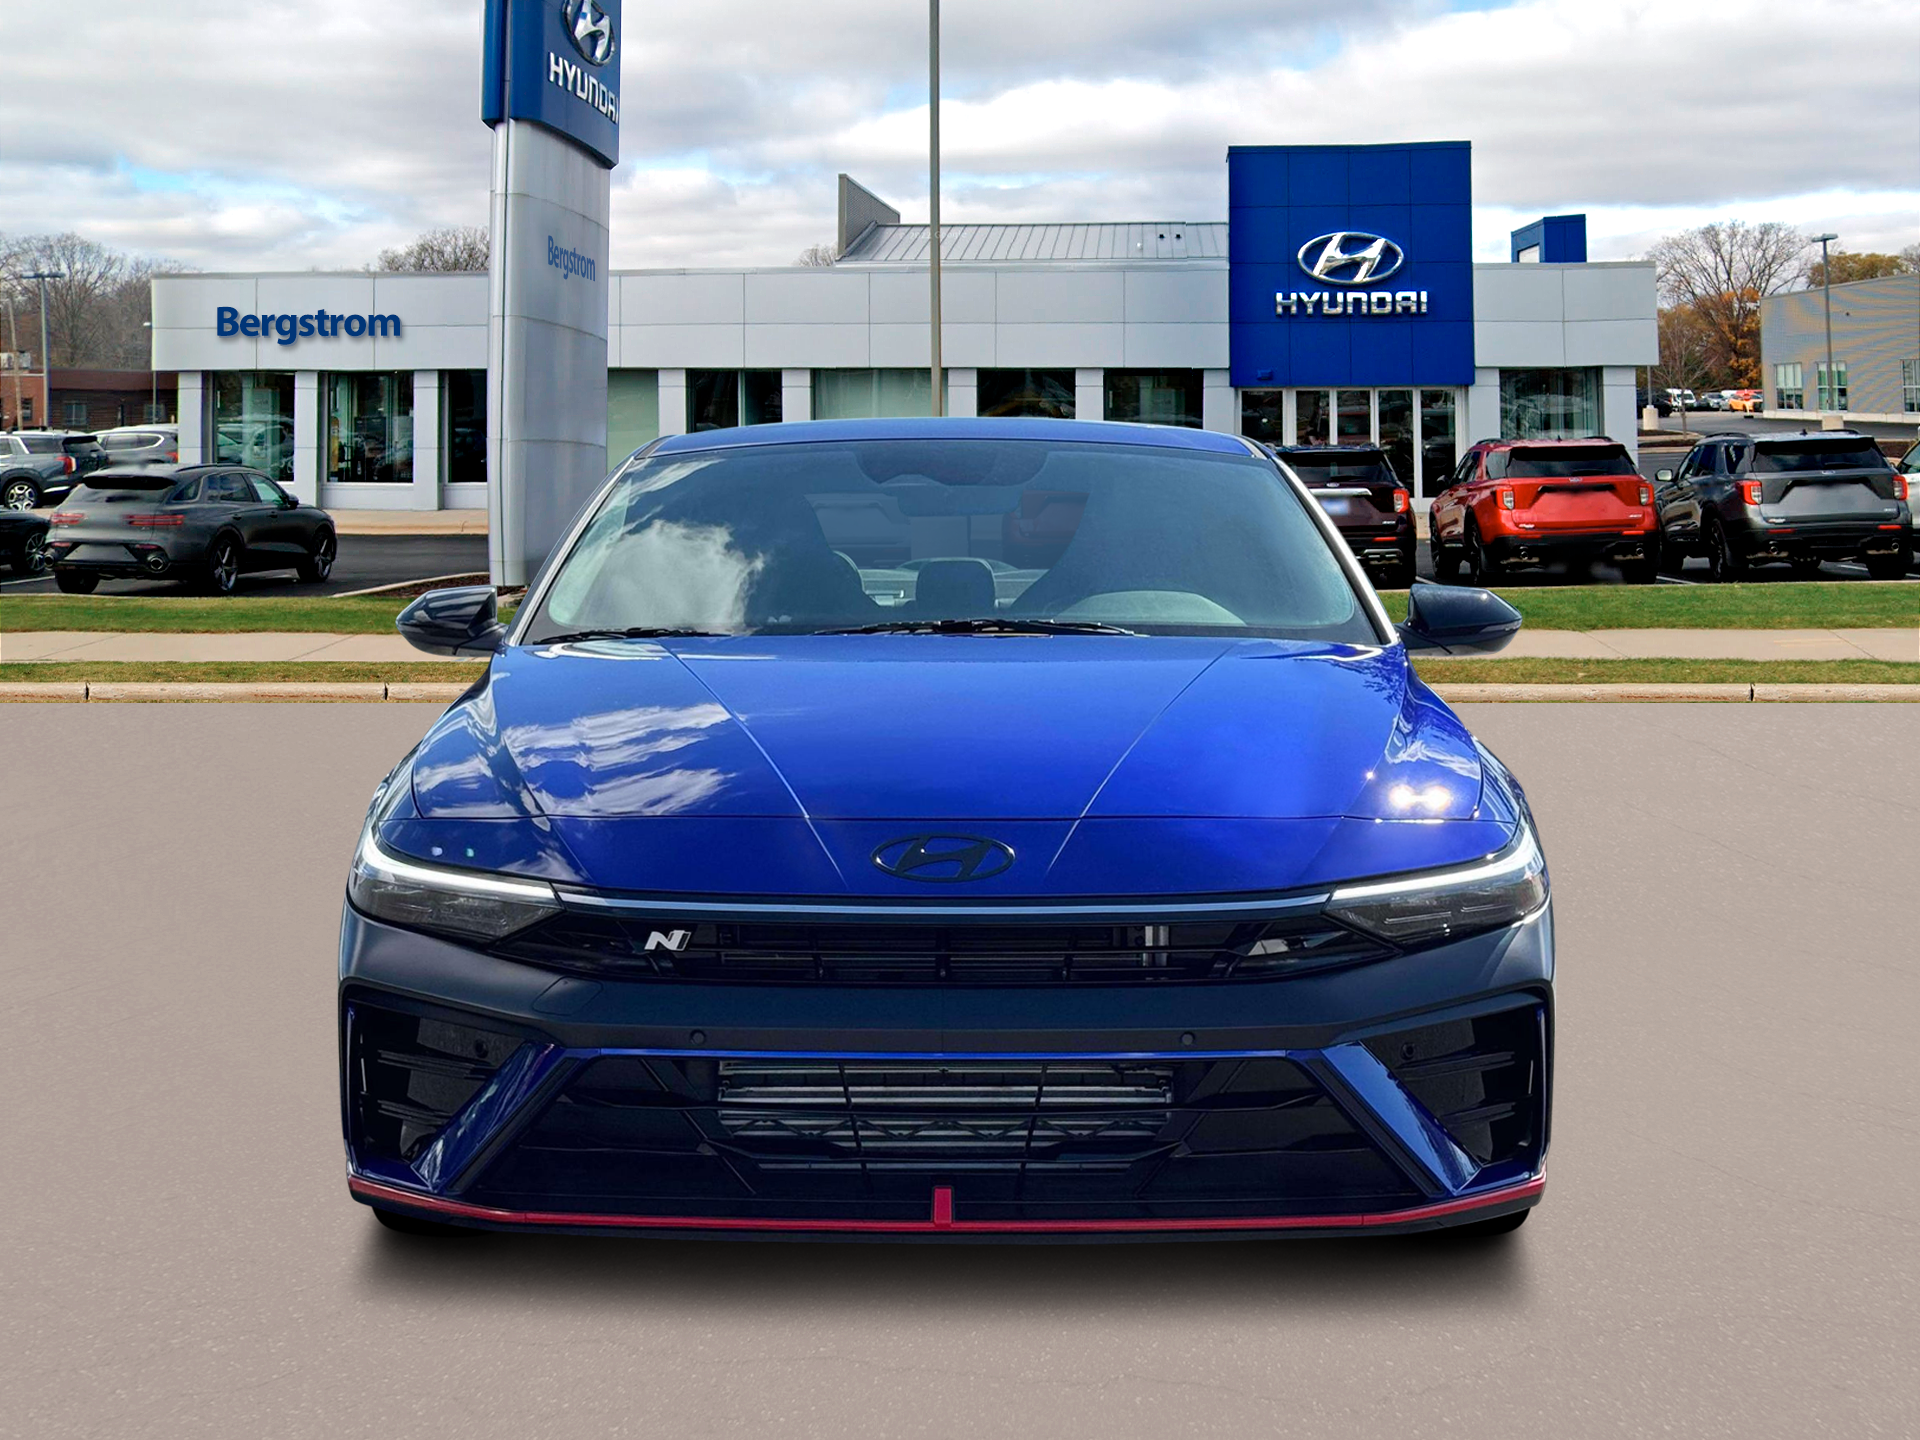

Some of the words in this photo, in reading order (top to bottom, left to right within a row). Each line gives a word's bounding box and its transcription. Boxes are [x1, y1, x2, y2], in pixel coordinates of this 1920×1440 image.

[549, 52, 618, 124] HYUNDAI
[547, 235, 595, 281] Bergstrom
[1275, 291, 1427, 314] HYUNDAI
[217, 307, 401, 345] Bergstrom
